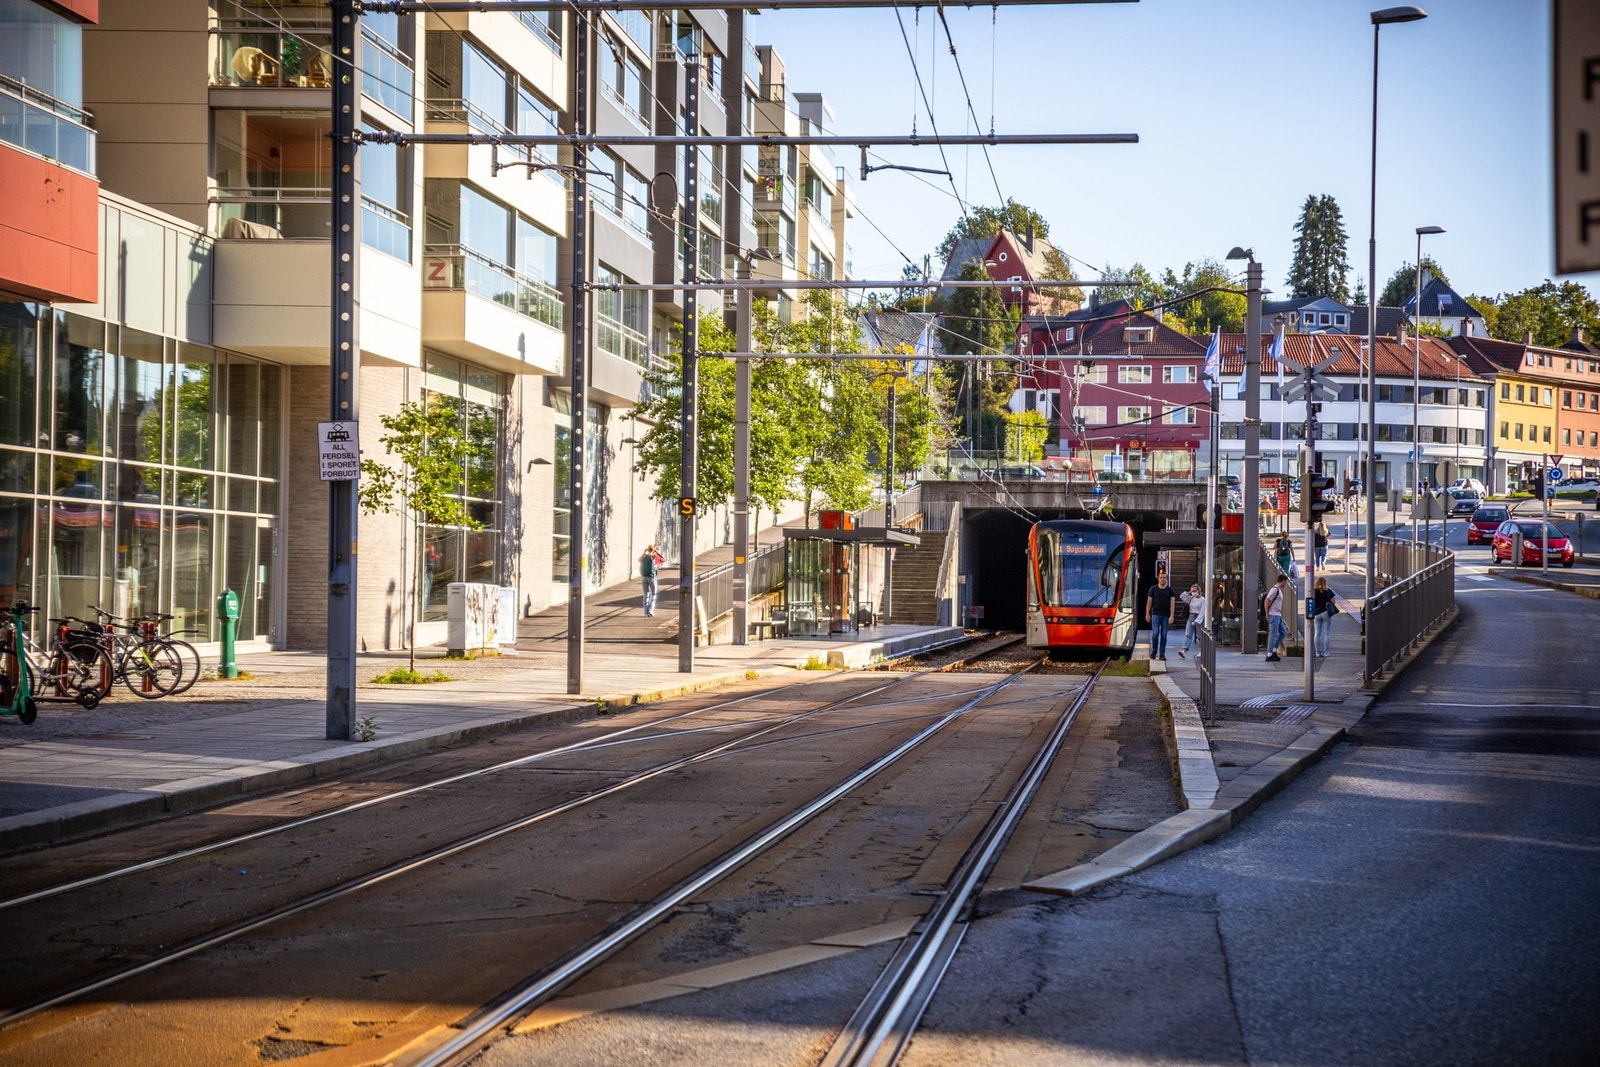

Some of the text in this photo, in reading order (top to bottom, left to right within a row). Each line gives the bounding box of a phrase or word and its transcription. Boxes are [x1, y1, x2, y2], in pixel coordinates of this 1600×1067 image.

[428, 262, 445, 280] Z
[322, 452, 356, 460] FERDSEL
[327, 461, 357, 469] SPORET
[322, 470, 357, 478] FORBUDT
[681, 499, 693, 514] S
